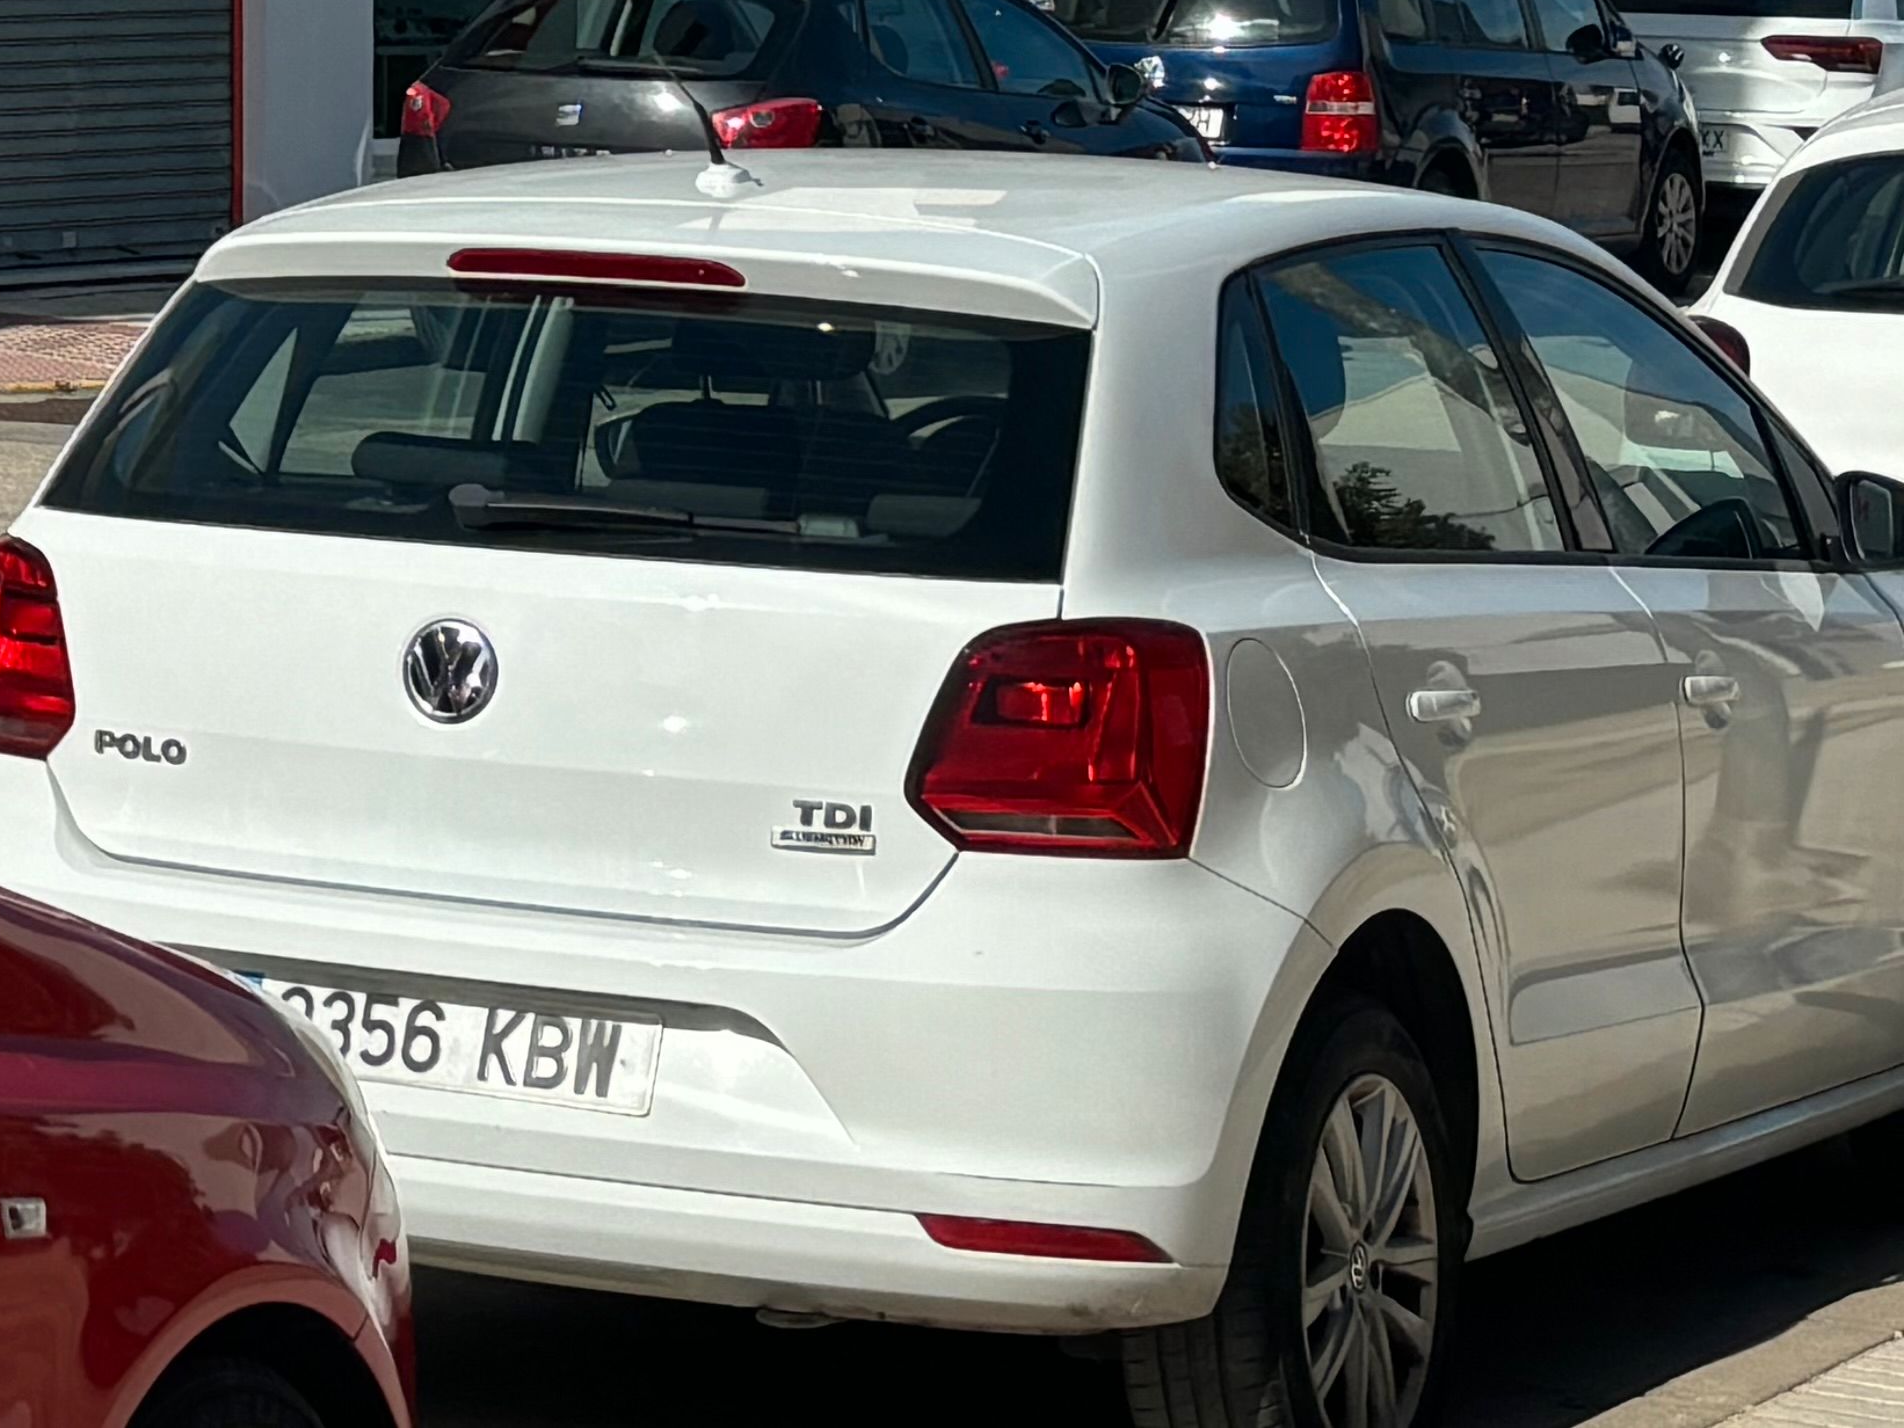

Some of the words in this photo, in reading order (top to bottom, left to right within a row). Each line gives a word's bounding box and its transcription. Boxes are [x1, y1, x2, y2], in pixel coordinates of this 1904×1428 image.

[94, 729, 187, 765] POLO
[792, 799, 873, 832] TDI
[477, 1007, 623, 1098] KBW
